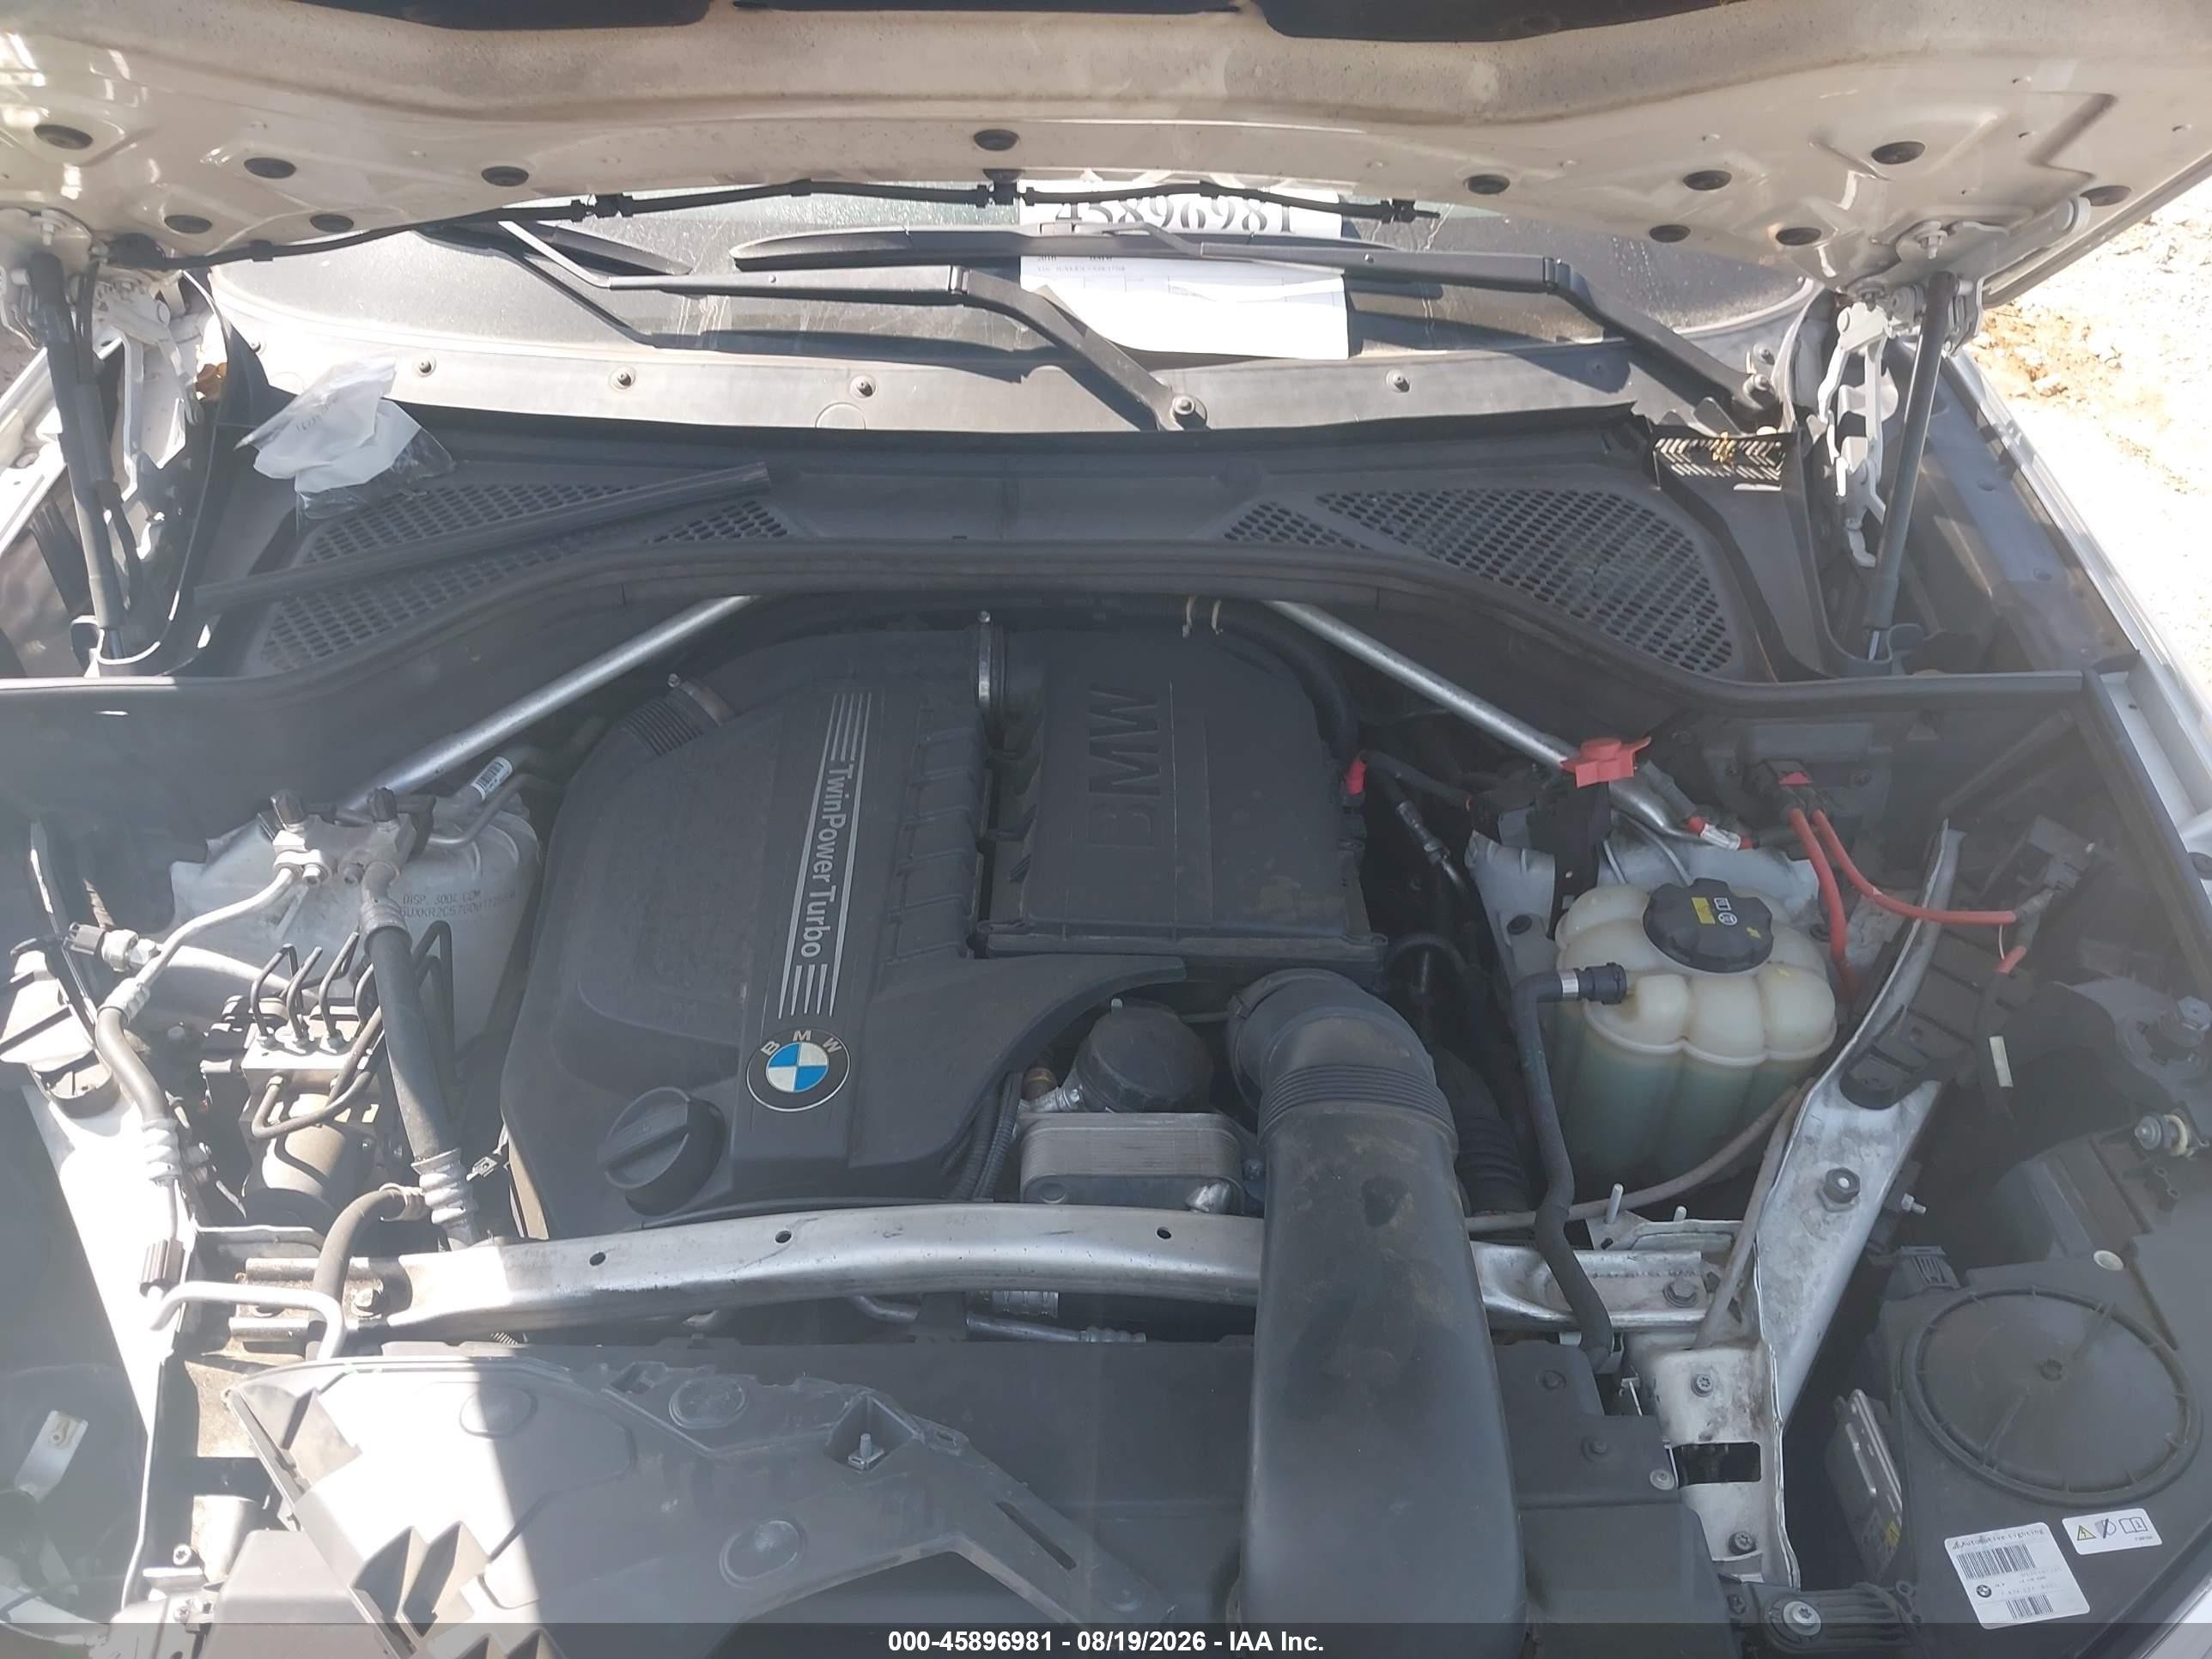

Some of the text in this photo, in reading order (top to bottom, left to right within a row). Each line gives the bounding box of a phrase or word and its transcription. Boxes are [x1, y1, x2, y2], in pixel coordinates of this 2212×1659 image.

[1086, 684, 1162, 849] BMW
[800, 763, 854, 958] TwinPower Turbo
[760, 1030, 842, 1057] BMW
